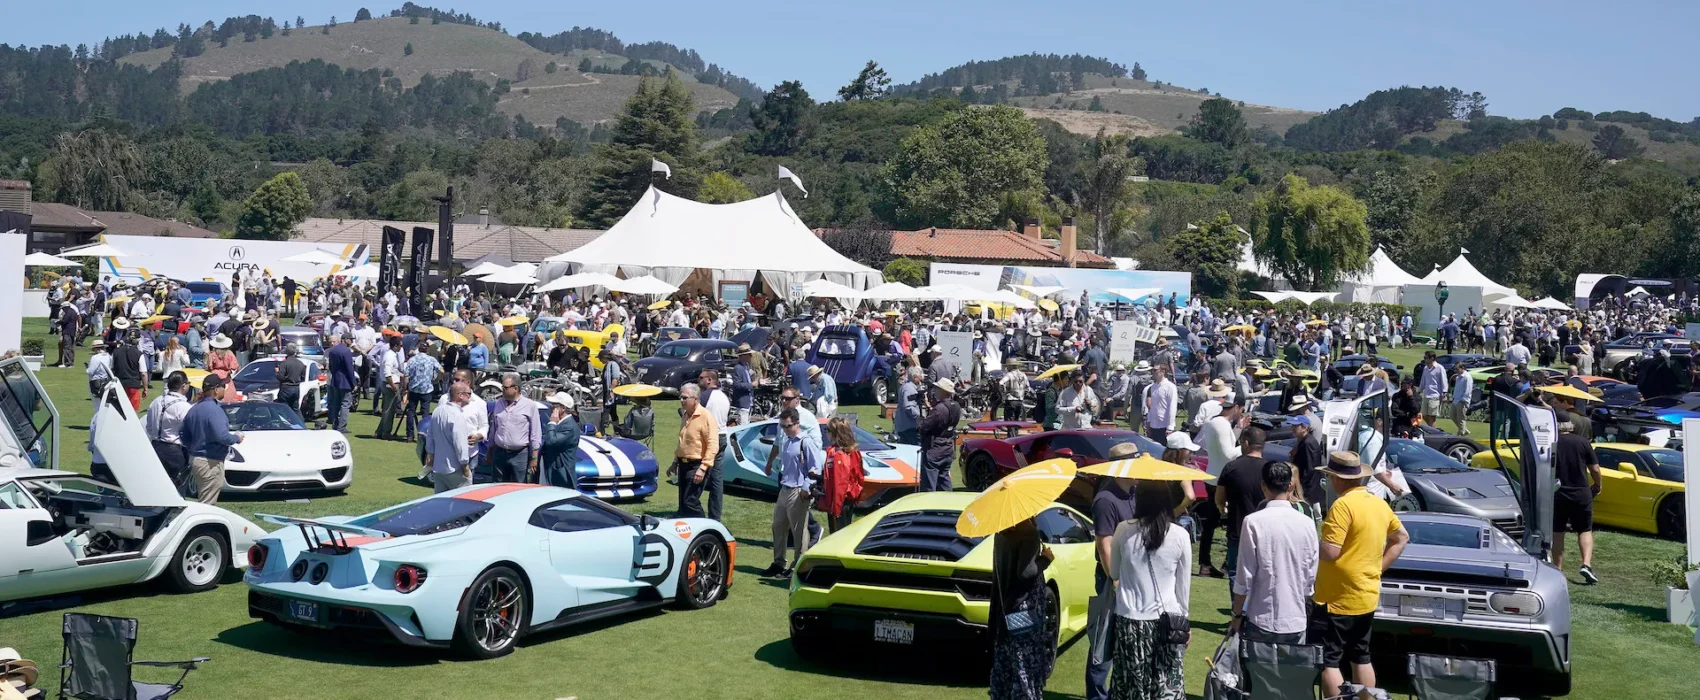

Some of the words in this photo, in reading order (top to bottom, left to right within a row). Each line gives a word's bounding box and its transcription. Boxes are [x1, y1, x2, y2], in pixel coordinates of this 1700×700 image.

[214, 262, 260, 271] ACURA
[415, 242, 424, 293] ACURA
[675, 525, 692, 533] Gulf
[298, 604, 306, 616] GT
[308, 605, 313, 617] 9
[876, 627, 913, 641] LIMACAN
